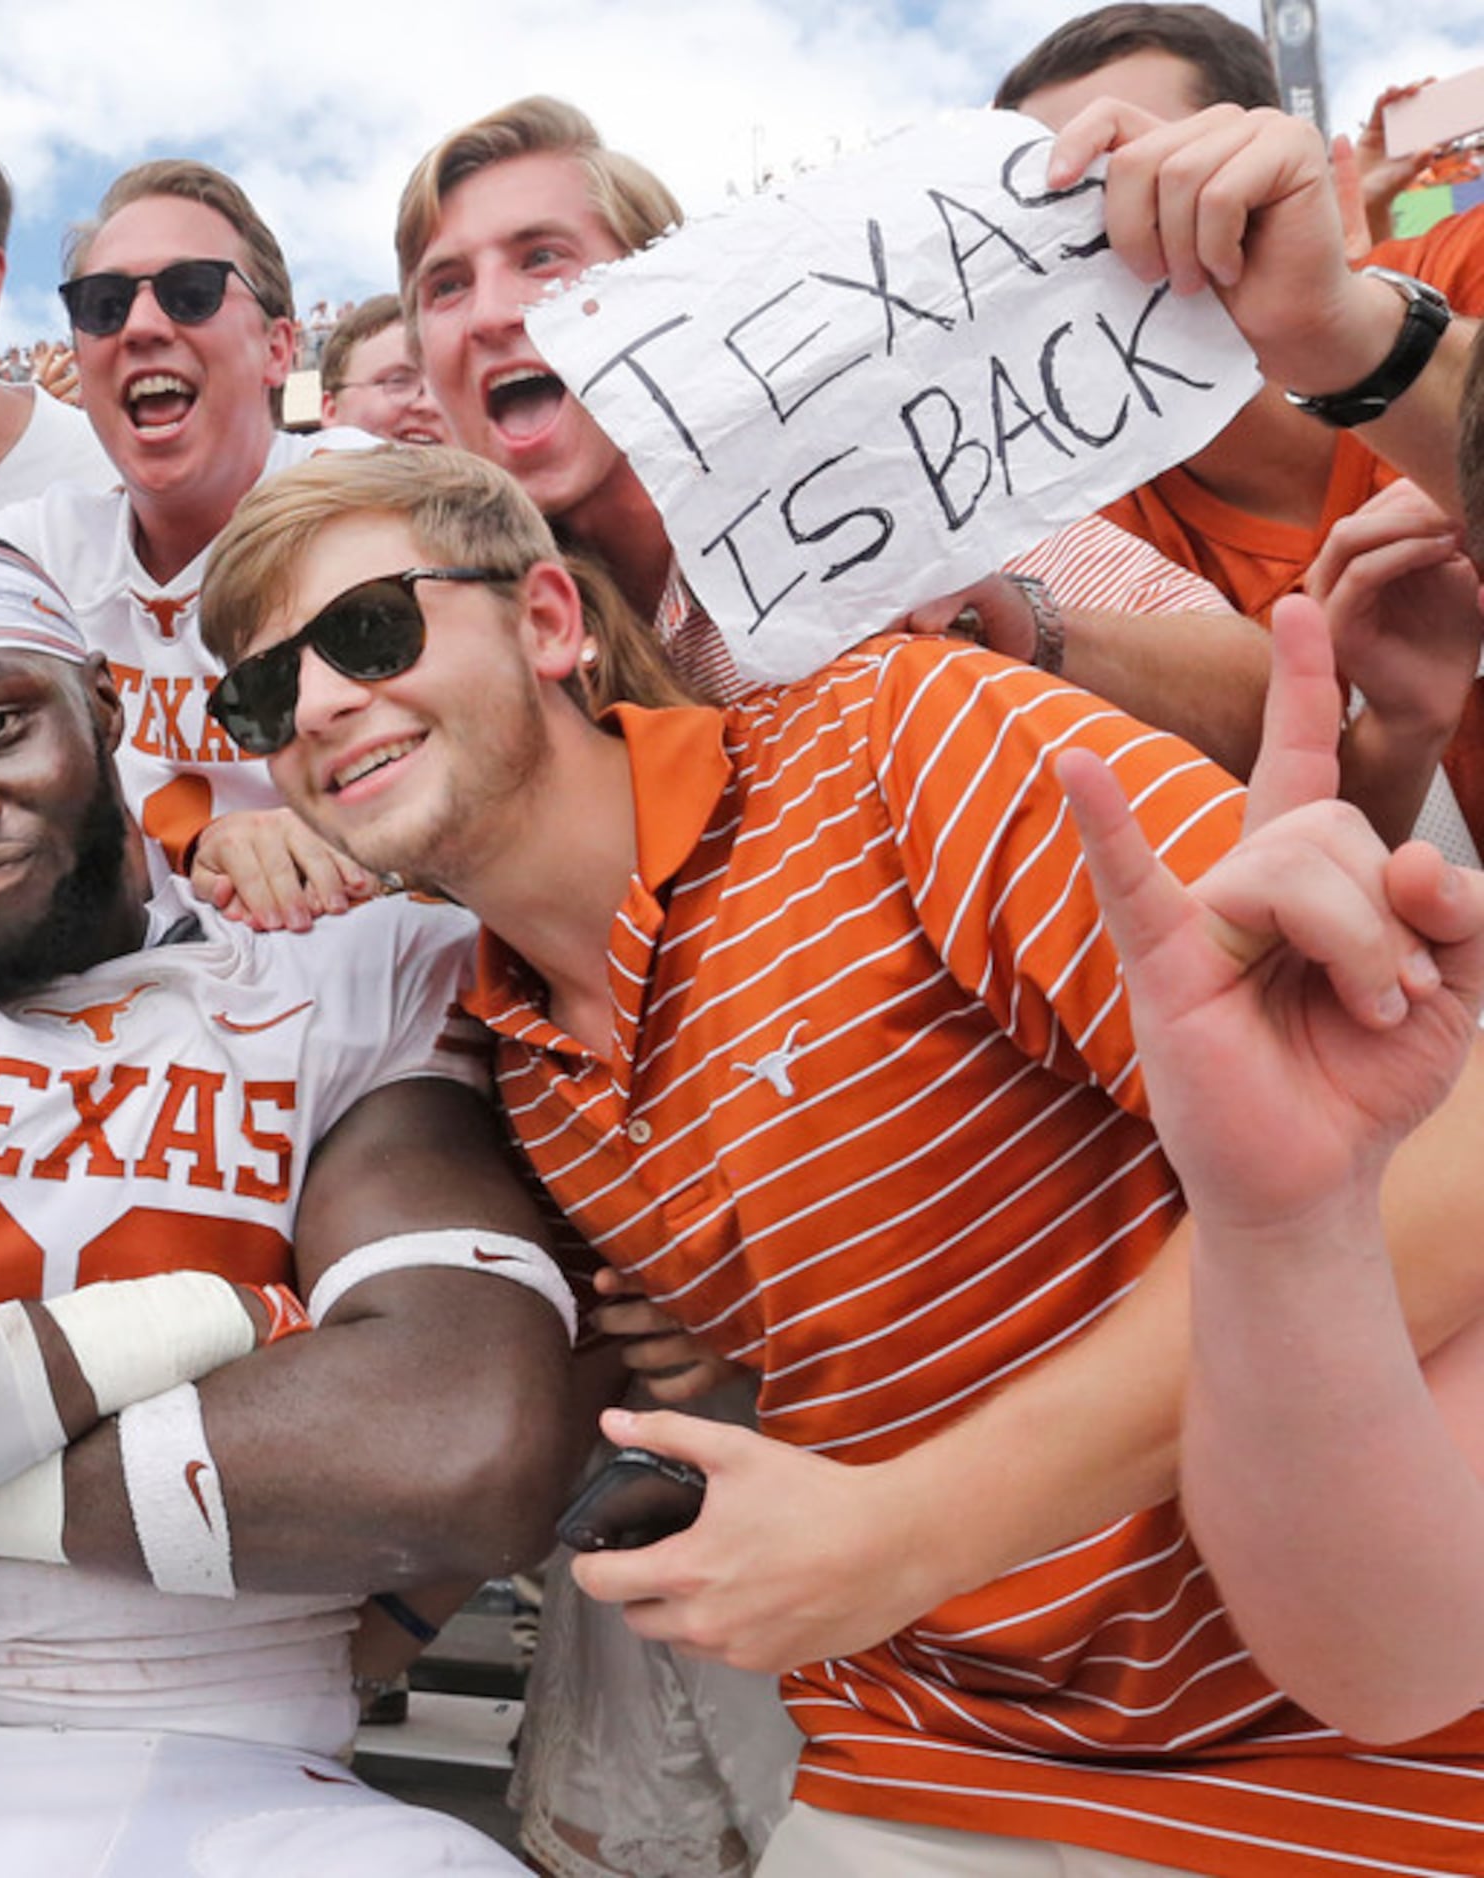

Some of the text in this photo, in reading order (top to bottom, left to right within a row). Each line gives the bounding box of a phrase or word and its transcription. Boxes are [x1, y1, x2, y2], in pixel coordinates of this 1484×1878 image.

[580, 136, 1111, 473] TEXAS
[702, 281, 1215, 634] IS BACK
[108, 662, 263, 762] TEXA
